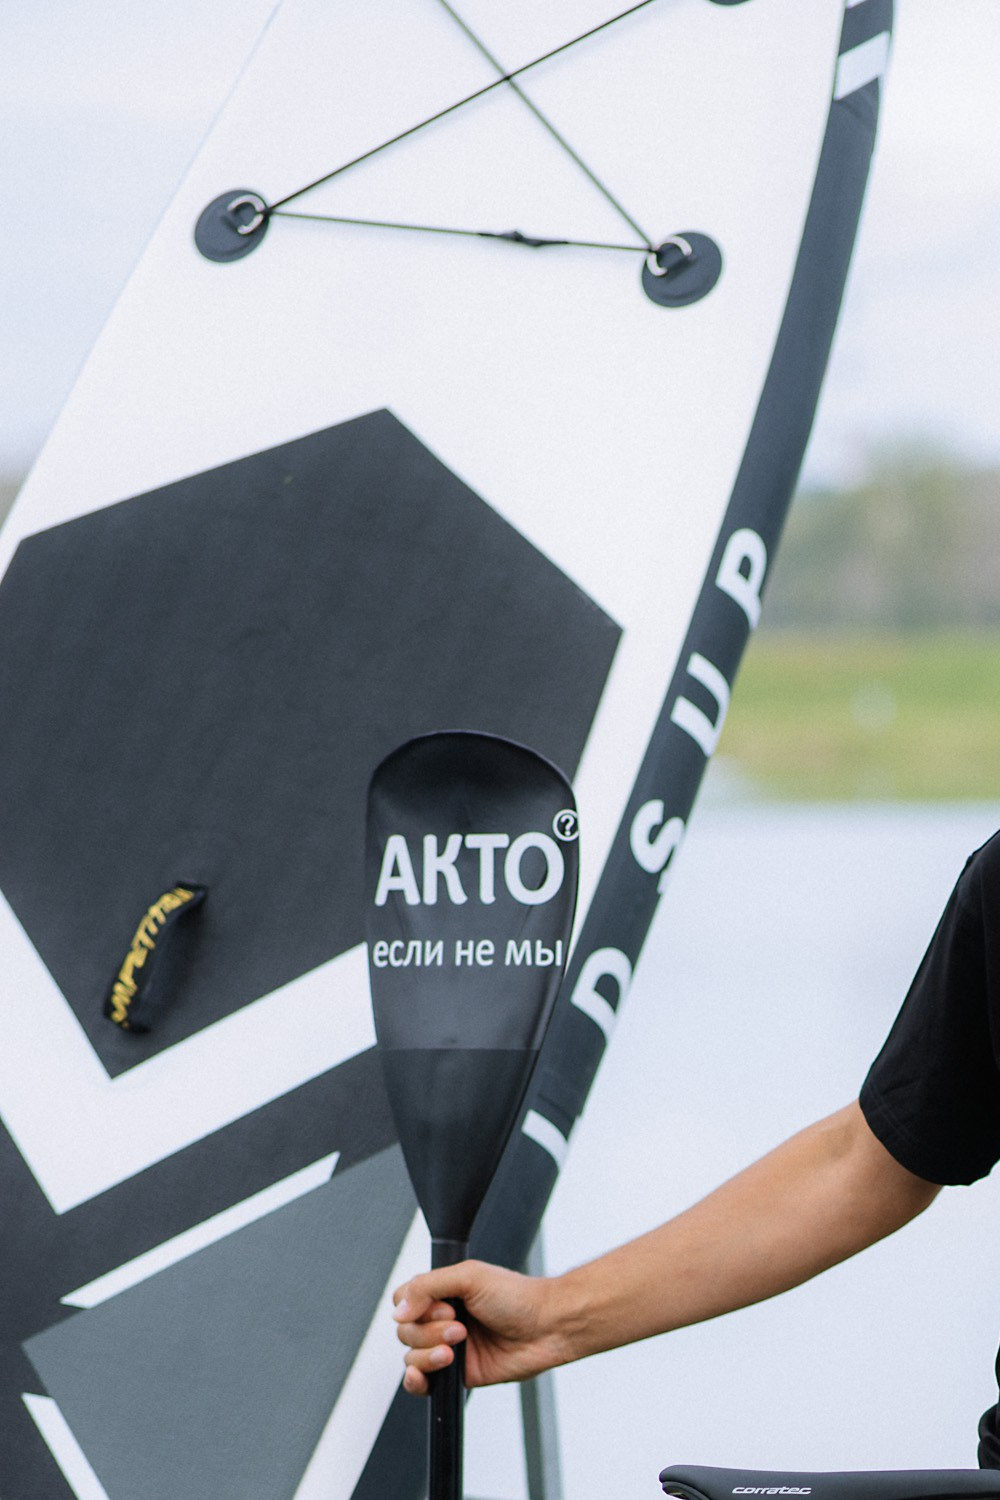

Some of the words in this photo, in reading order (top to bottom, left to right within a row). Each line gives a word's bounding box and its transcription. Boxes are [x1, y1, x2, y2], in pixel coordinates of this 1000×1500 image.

[374, 831, 565, 906] АКТО
[372, 939, 444, 968] если
[454, 938, 495, 967] не
[504, 939, 563, 967] мы
[731, 1486, 812, 1495] corratec
